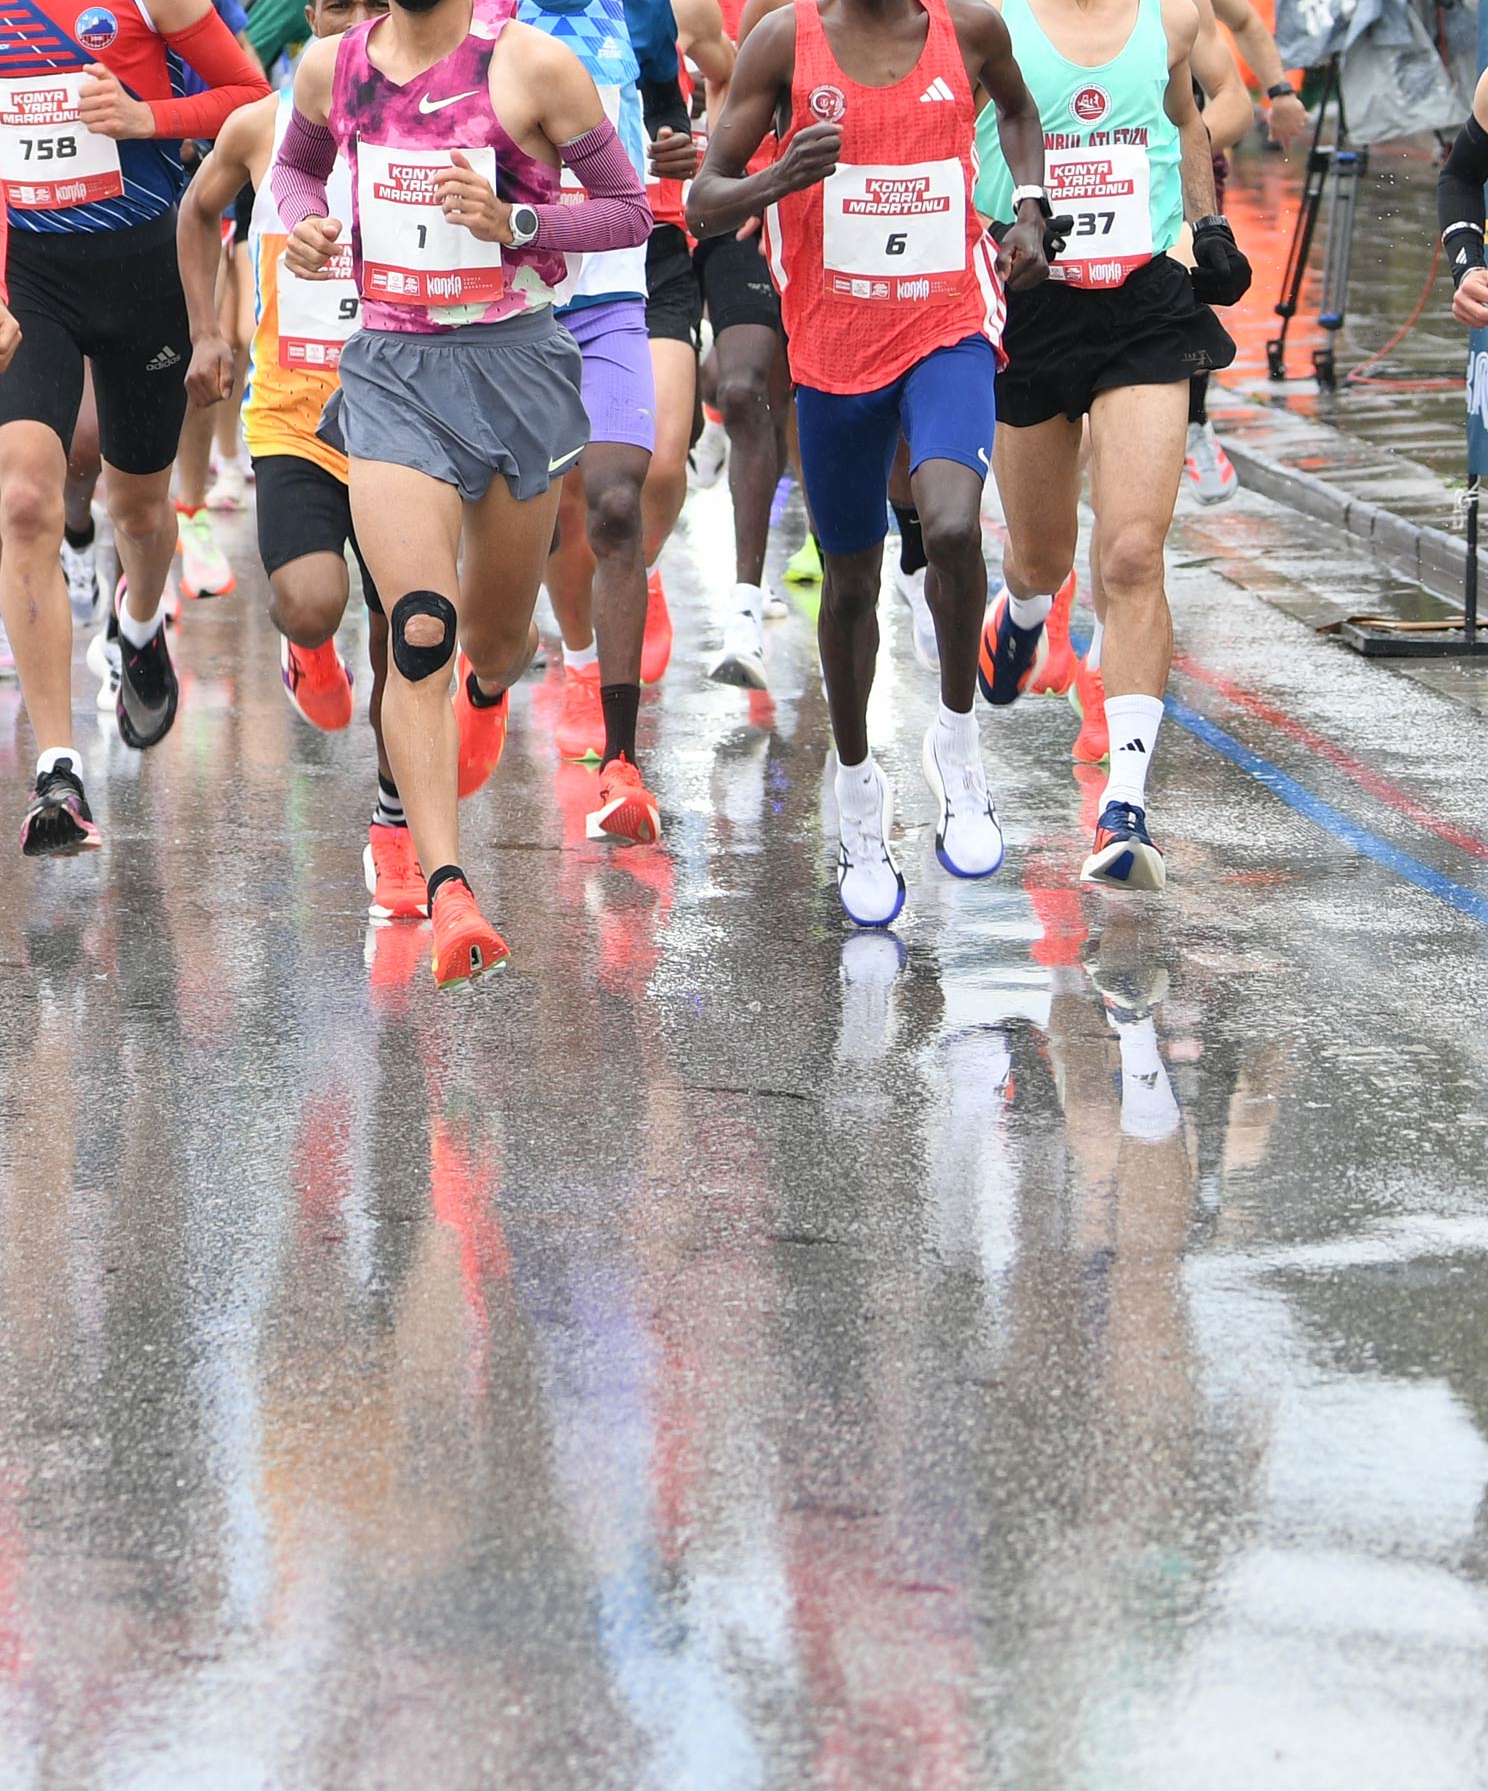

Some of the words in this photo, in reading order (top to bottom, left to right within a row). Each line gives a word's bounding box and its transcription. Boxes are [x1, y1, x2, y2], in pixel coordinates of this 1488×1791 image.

[14, 91, 65, 106] KONYA
[23, 102, 58, 114] YARI
[19, 135, 77, 160] 758
[391, 166, 437, 180] KONY
[1054, 163, 1109, 178] KONYA
[870, 180, 926, 193] KONYA
[1062, 174, 1101, 186] YARI
[879, 190, 918, 203] YARI
[849, 199, 945, 214] MARATONU
[1076, 211, 1116, 236] 37
[416, 224, 428, 249] 1
[885, 233, 908, 256] 6
[338, 298, 359, 321] 9
[145, 354, 181, 371] adidas
